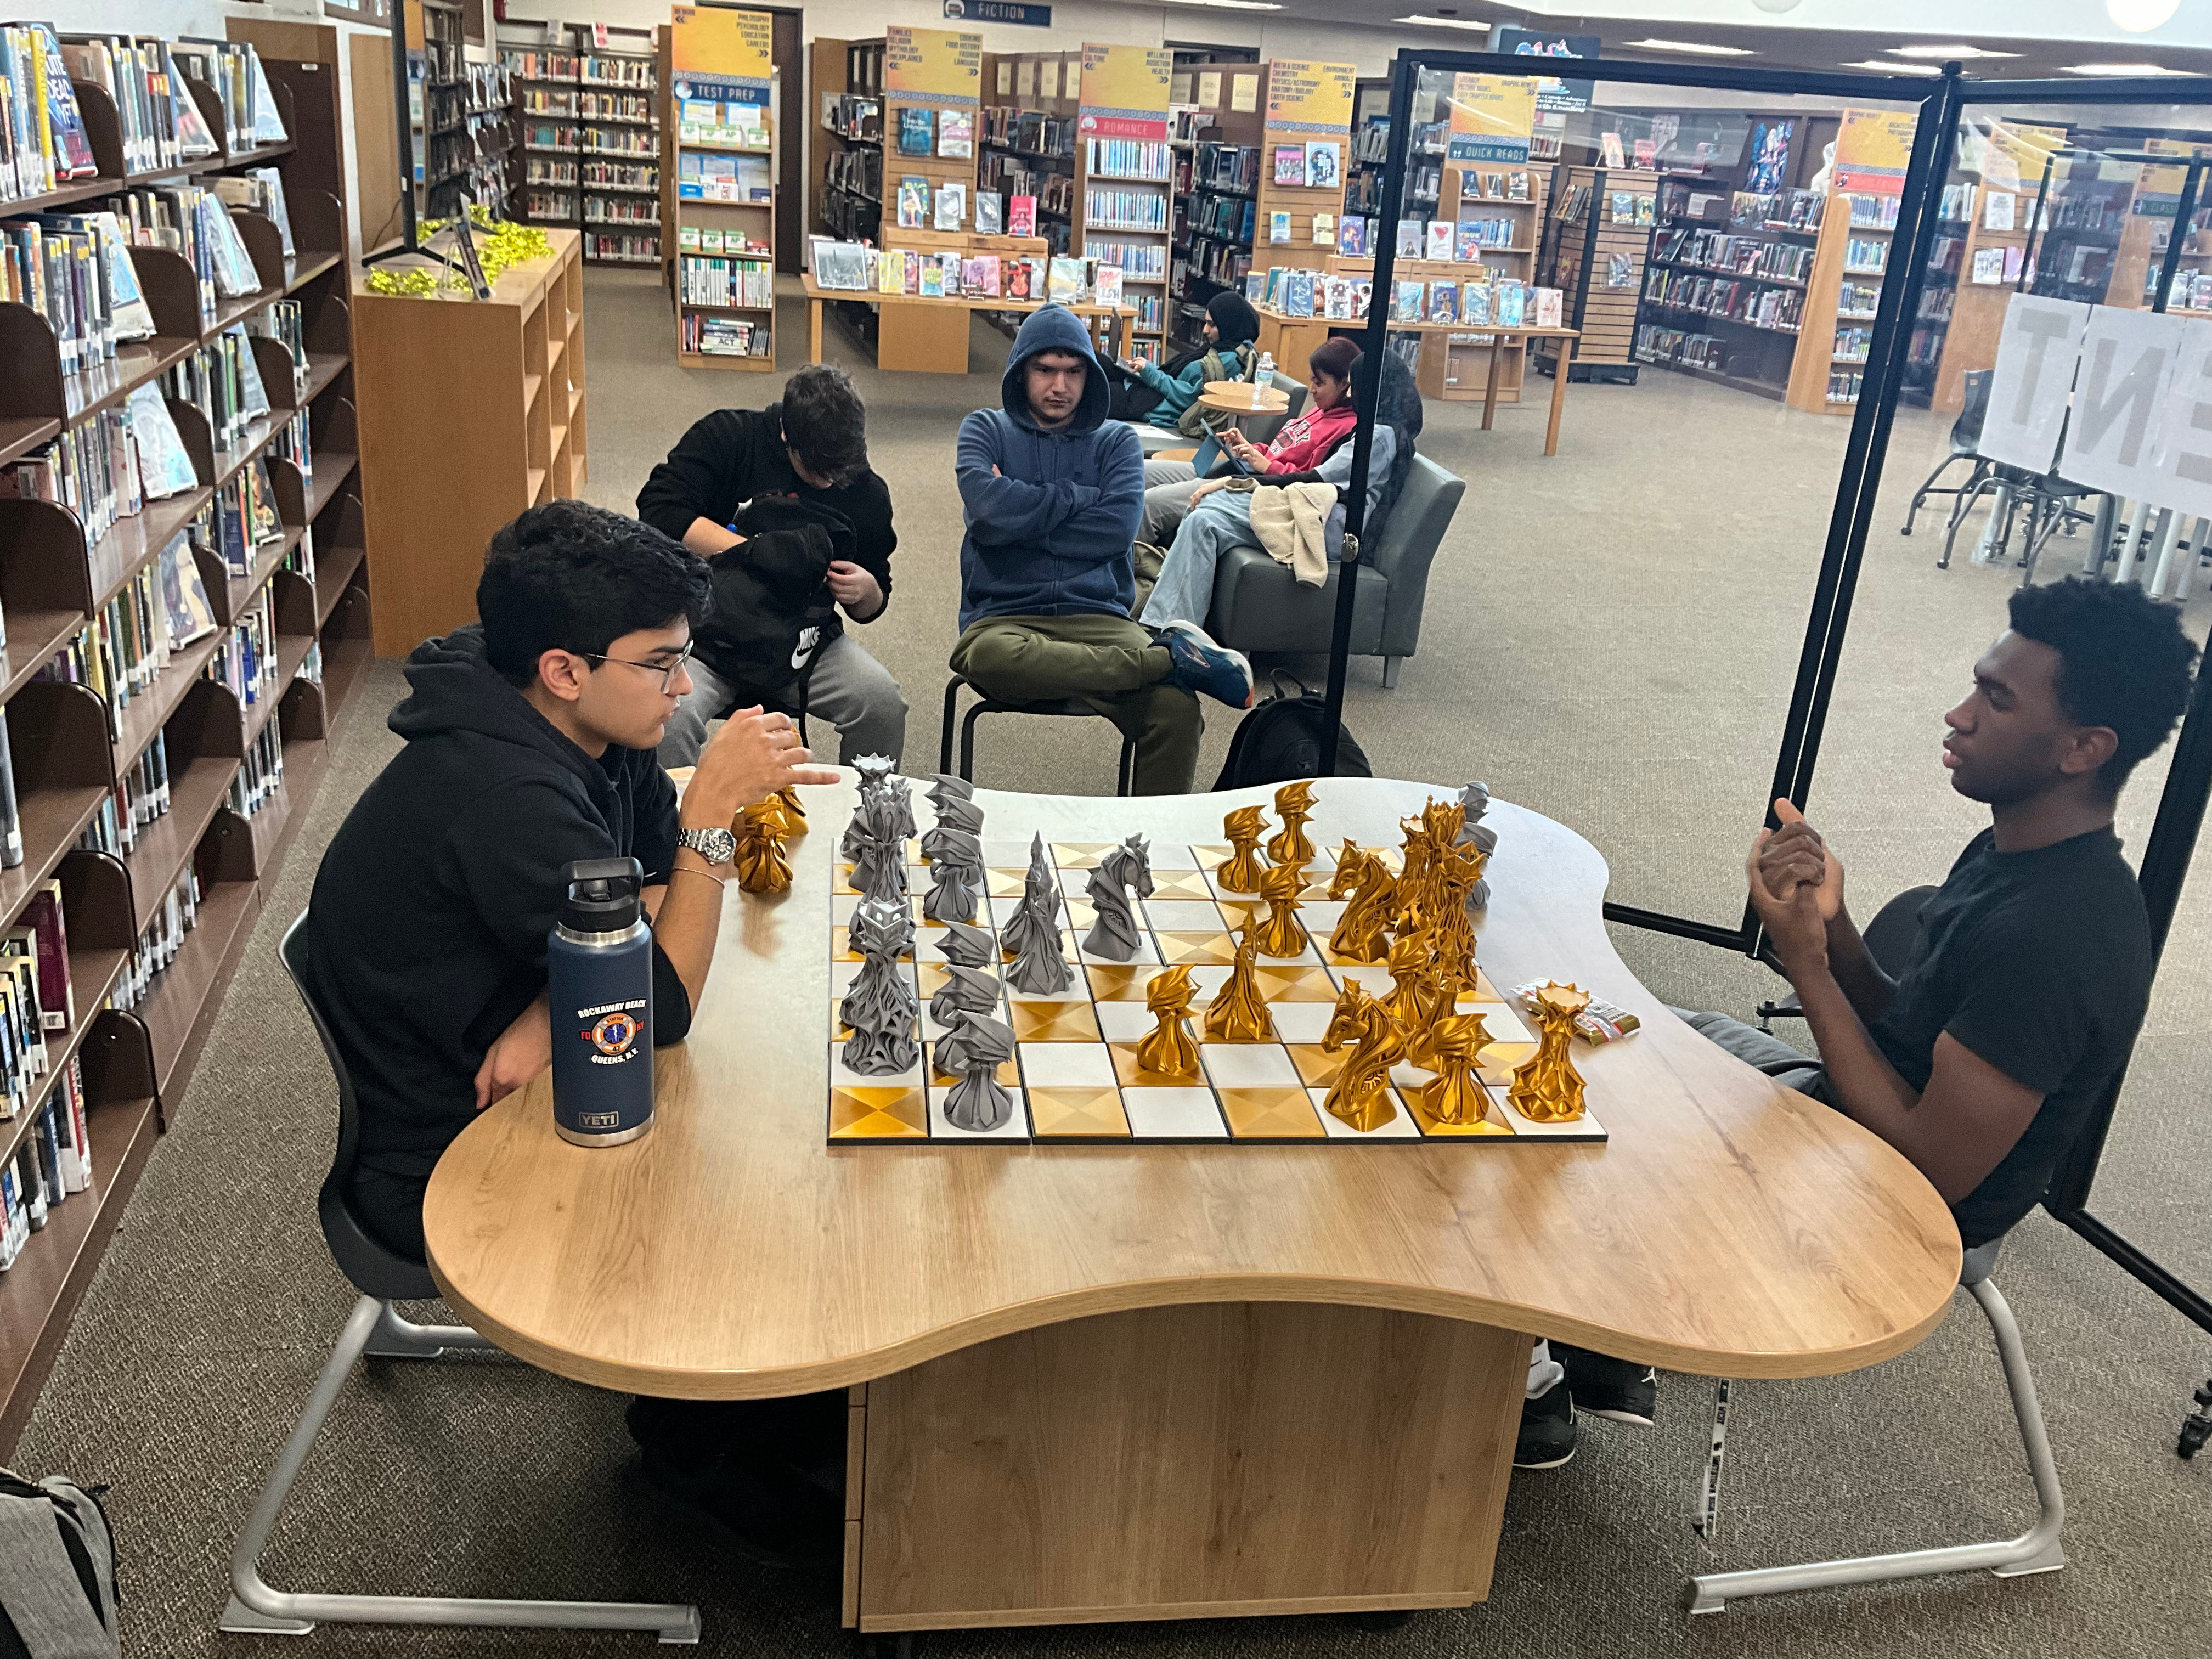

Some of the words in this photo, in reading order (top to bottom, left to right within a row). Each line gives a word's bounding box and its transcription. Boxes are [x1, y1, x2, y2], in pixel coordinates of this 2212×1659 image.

[978, 4, 1025, 19] FICTION
[738, 13, 769, 23] PHILOSOPHY
[736, 21, 769, 31] PSYCHOLOGY
[741, 31, 769, 40] EDUCATION
[889, 44, 918, 53] MYTHOLOGY
[946, 41, 958, 49] FOOD
[959, 42, 980, 52] HISTORY
[46, 55, 66, 76] UITE
[1323, 65, 1355, 74] ENVIRONMENT
[37, 48, 48, 98] KOONTZ
[1272, 70, 1299, 78] CHEMISTRY
[1272, 78, 1321, 87] PHYSICS/ASTRONOMY
[47, 79, 71, 100] DEAD
[698, 85, 723, 98] TEST
[729, 88, 755, 101] PREP
[1271, 86, 1314, 95] ANATOMY/BIOLOGY
[1285, 94, 1304, 103] SCIENCE
[1104, 121, 1149, 136] ROMANCE
[1466, 146, 1492, 158] QUICK
[1496, 149, 1524, 161] READS
[718, 338, 735, 346] ACT
[577, 1002, 624, 1018] ROCKAWAY
[625, 999, 646, 1009] BEACH
[636, 1020, 645, 1031] NY
[580, 1031, 591, 1040] FD
[625, 1047, 639, 1060] N.Y.
[582, 1114, 616, 1126] YETI
